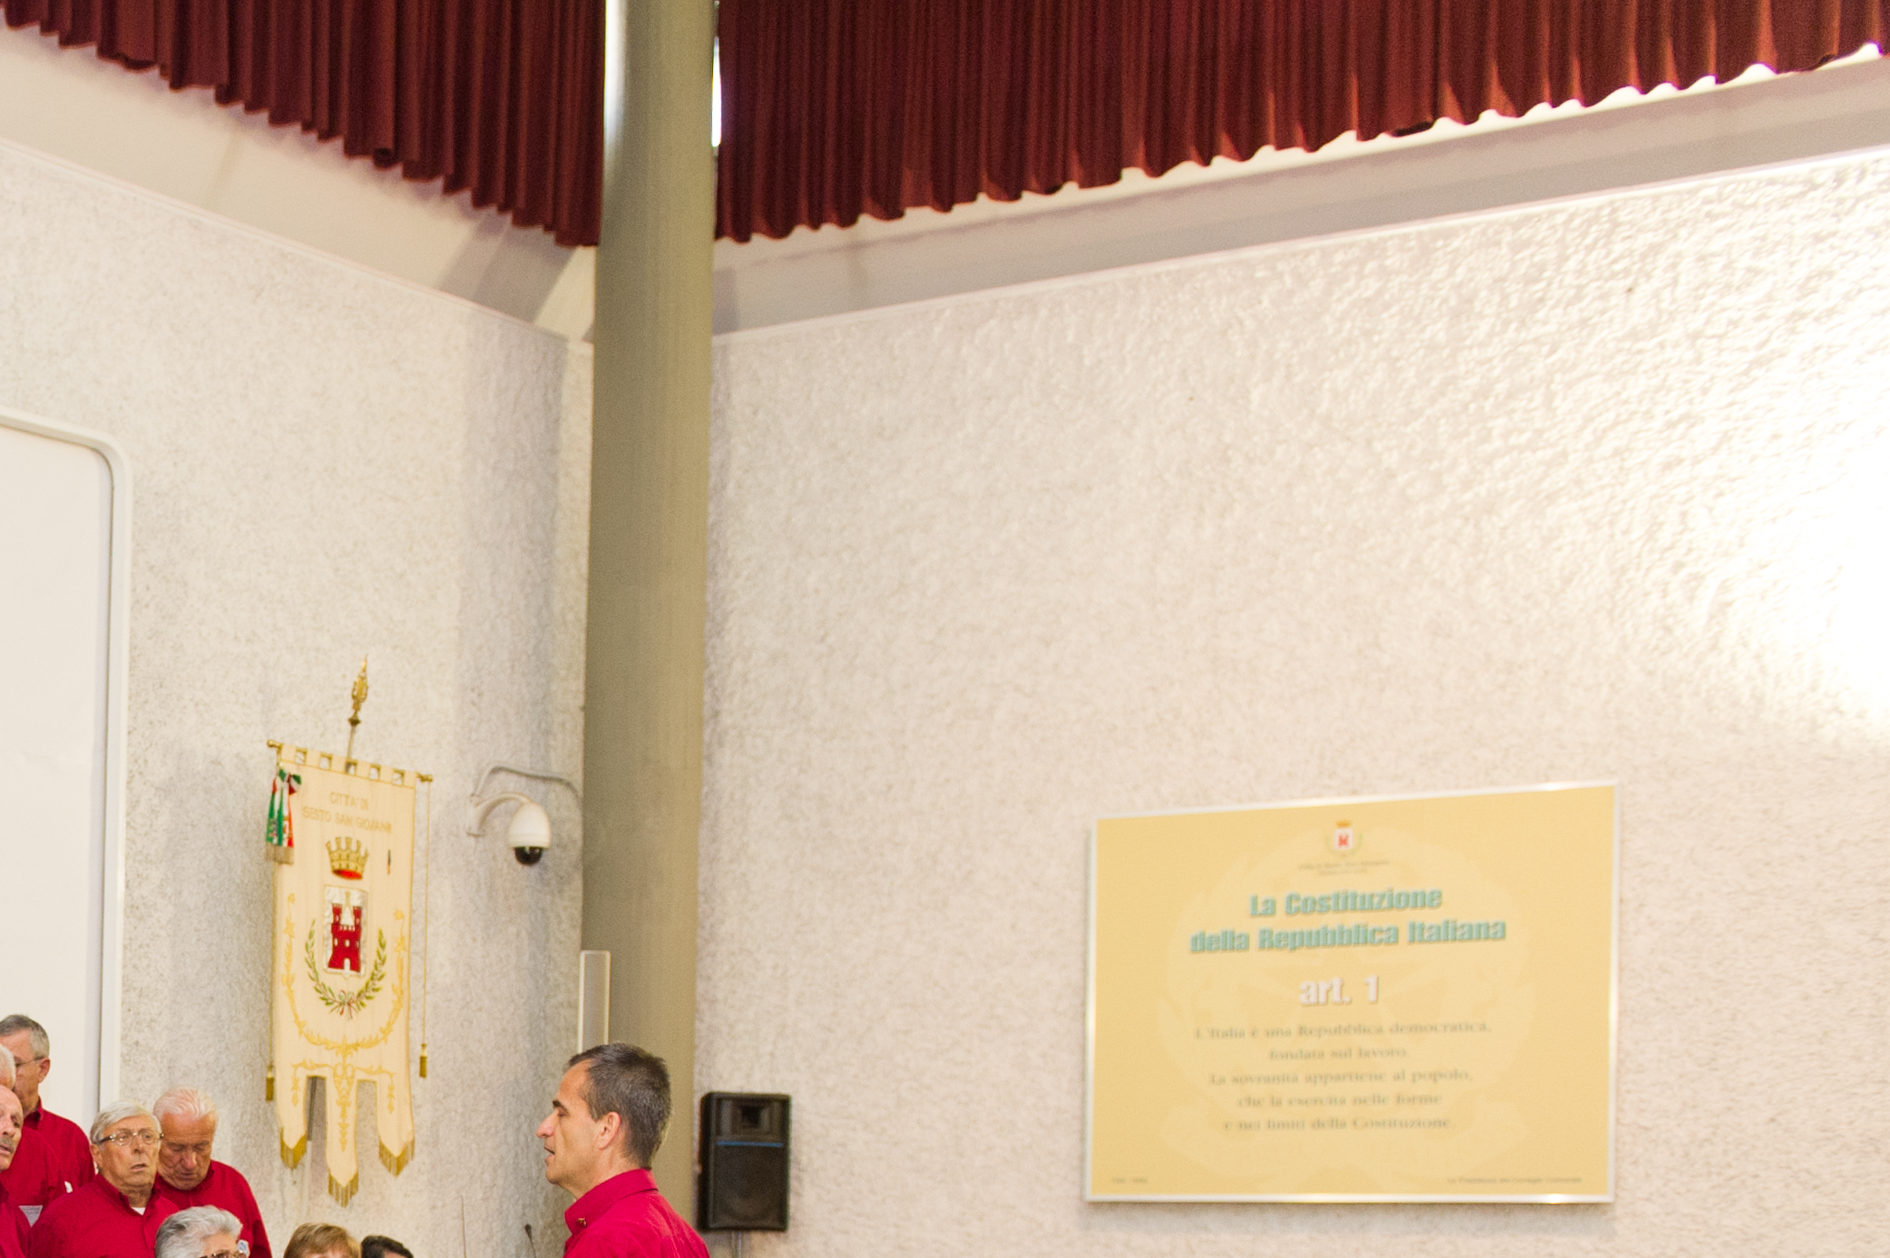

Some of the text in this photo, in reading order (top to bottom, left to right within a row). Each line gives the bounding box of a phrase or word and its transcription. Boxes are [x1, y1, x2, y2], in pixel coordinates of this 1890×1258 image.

[302, 805, 331, 822] SESTO
[335, 812, 353, 826] SAN
[1249, 887, 1443, 917] La Costituzione
[1190, 918, 1506, 954] della Repubblica Italiana
[1299, 974, 1380, 1006] art. 1
[1266, 1028, 1293, 1038] una
[1298, 1023, 1384, 1042] Repubblica
[1269, 1048, 1325, 1061] fondata
[1331, 1047, 1353, 1059] sul
[1305, 1070, 1387, 1087] appartiene
[1392, 1068, 1406, 1081] al
[1396, 1093, 1443, 1106] forme
[1311, 1117, 1348, 1130] della
